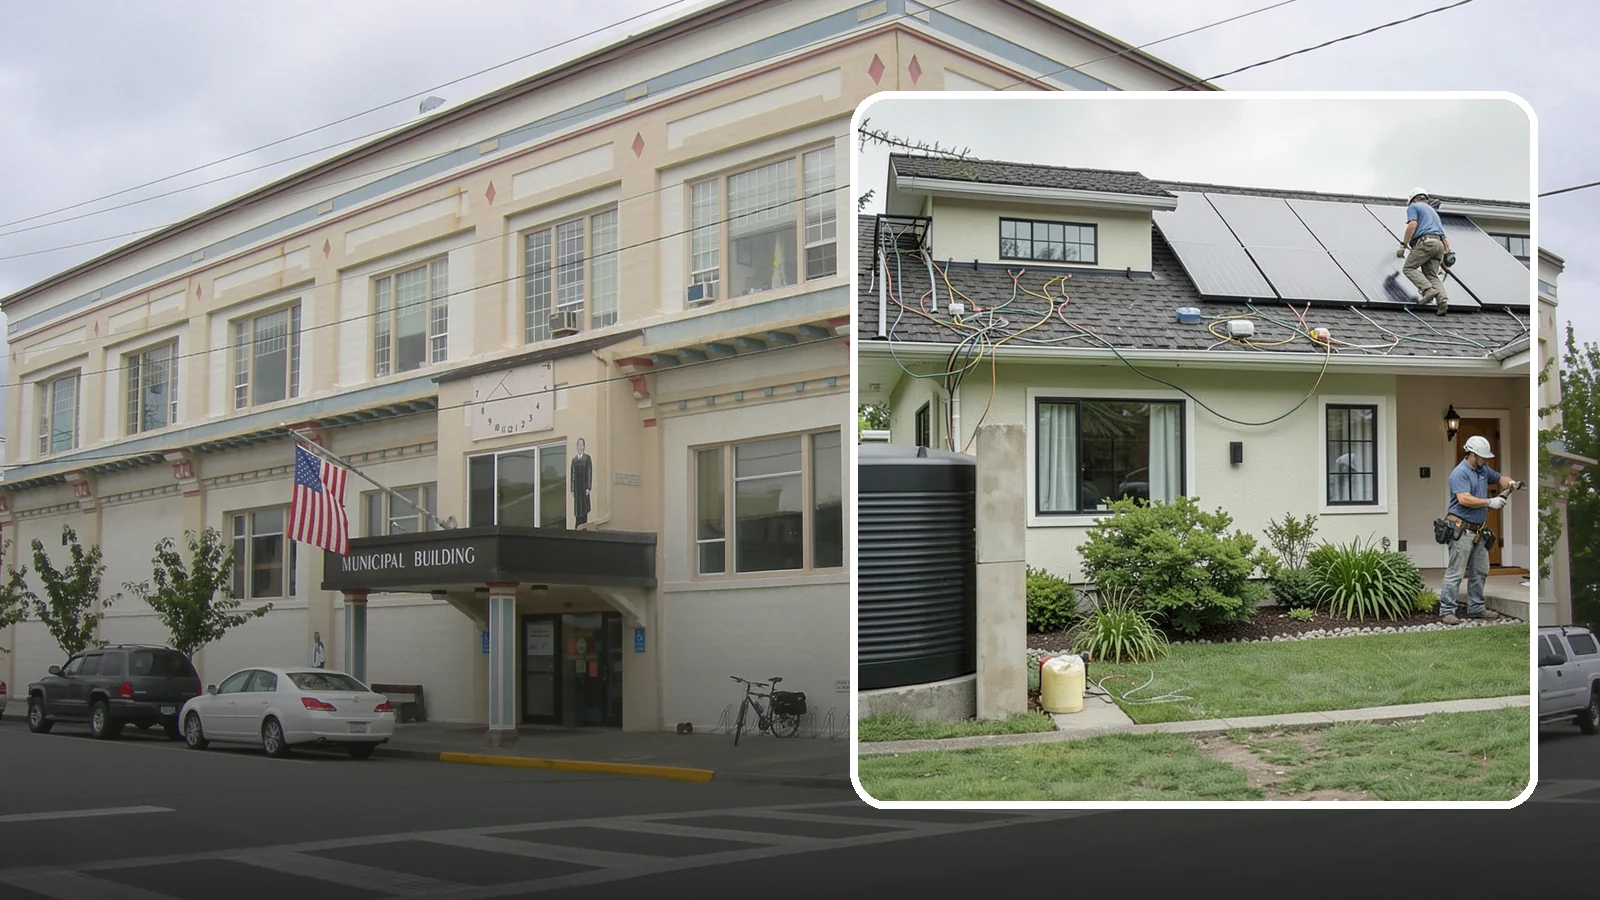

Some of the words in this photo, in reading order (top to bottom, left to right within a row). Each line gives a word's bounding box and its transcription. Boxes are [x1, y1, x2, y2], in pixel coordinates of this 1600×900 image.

[481, 407, 485, 415] 8
[488, 417, 492, 425] 9
[494, 423, 500, 431] 10
[502, 425, 506, 433] 11
[507, 425, 513, 433] 12
[521, 420, 525, 428] 2
[529, 414, 533, 422] 3
[536, 402, 540, 410] 4
[546, 361, 551, 370] 6
[342, 552, 405, 572] MUNICIPAL
[414, 546, 475, 567] BUILDING
